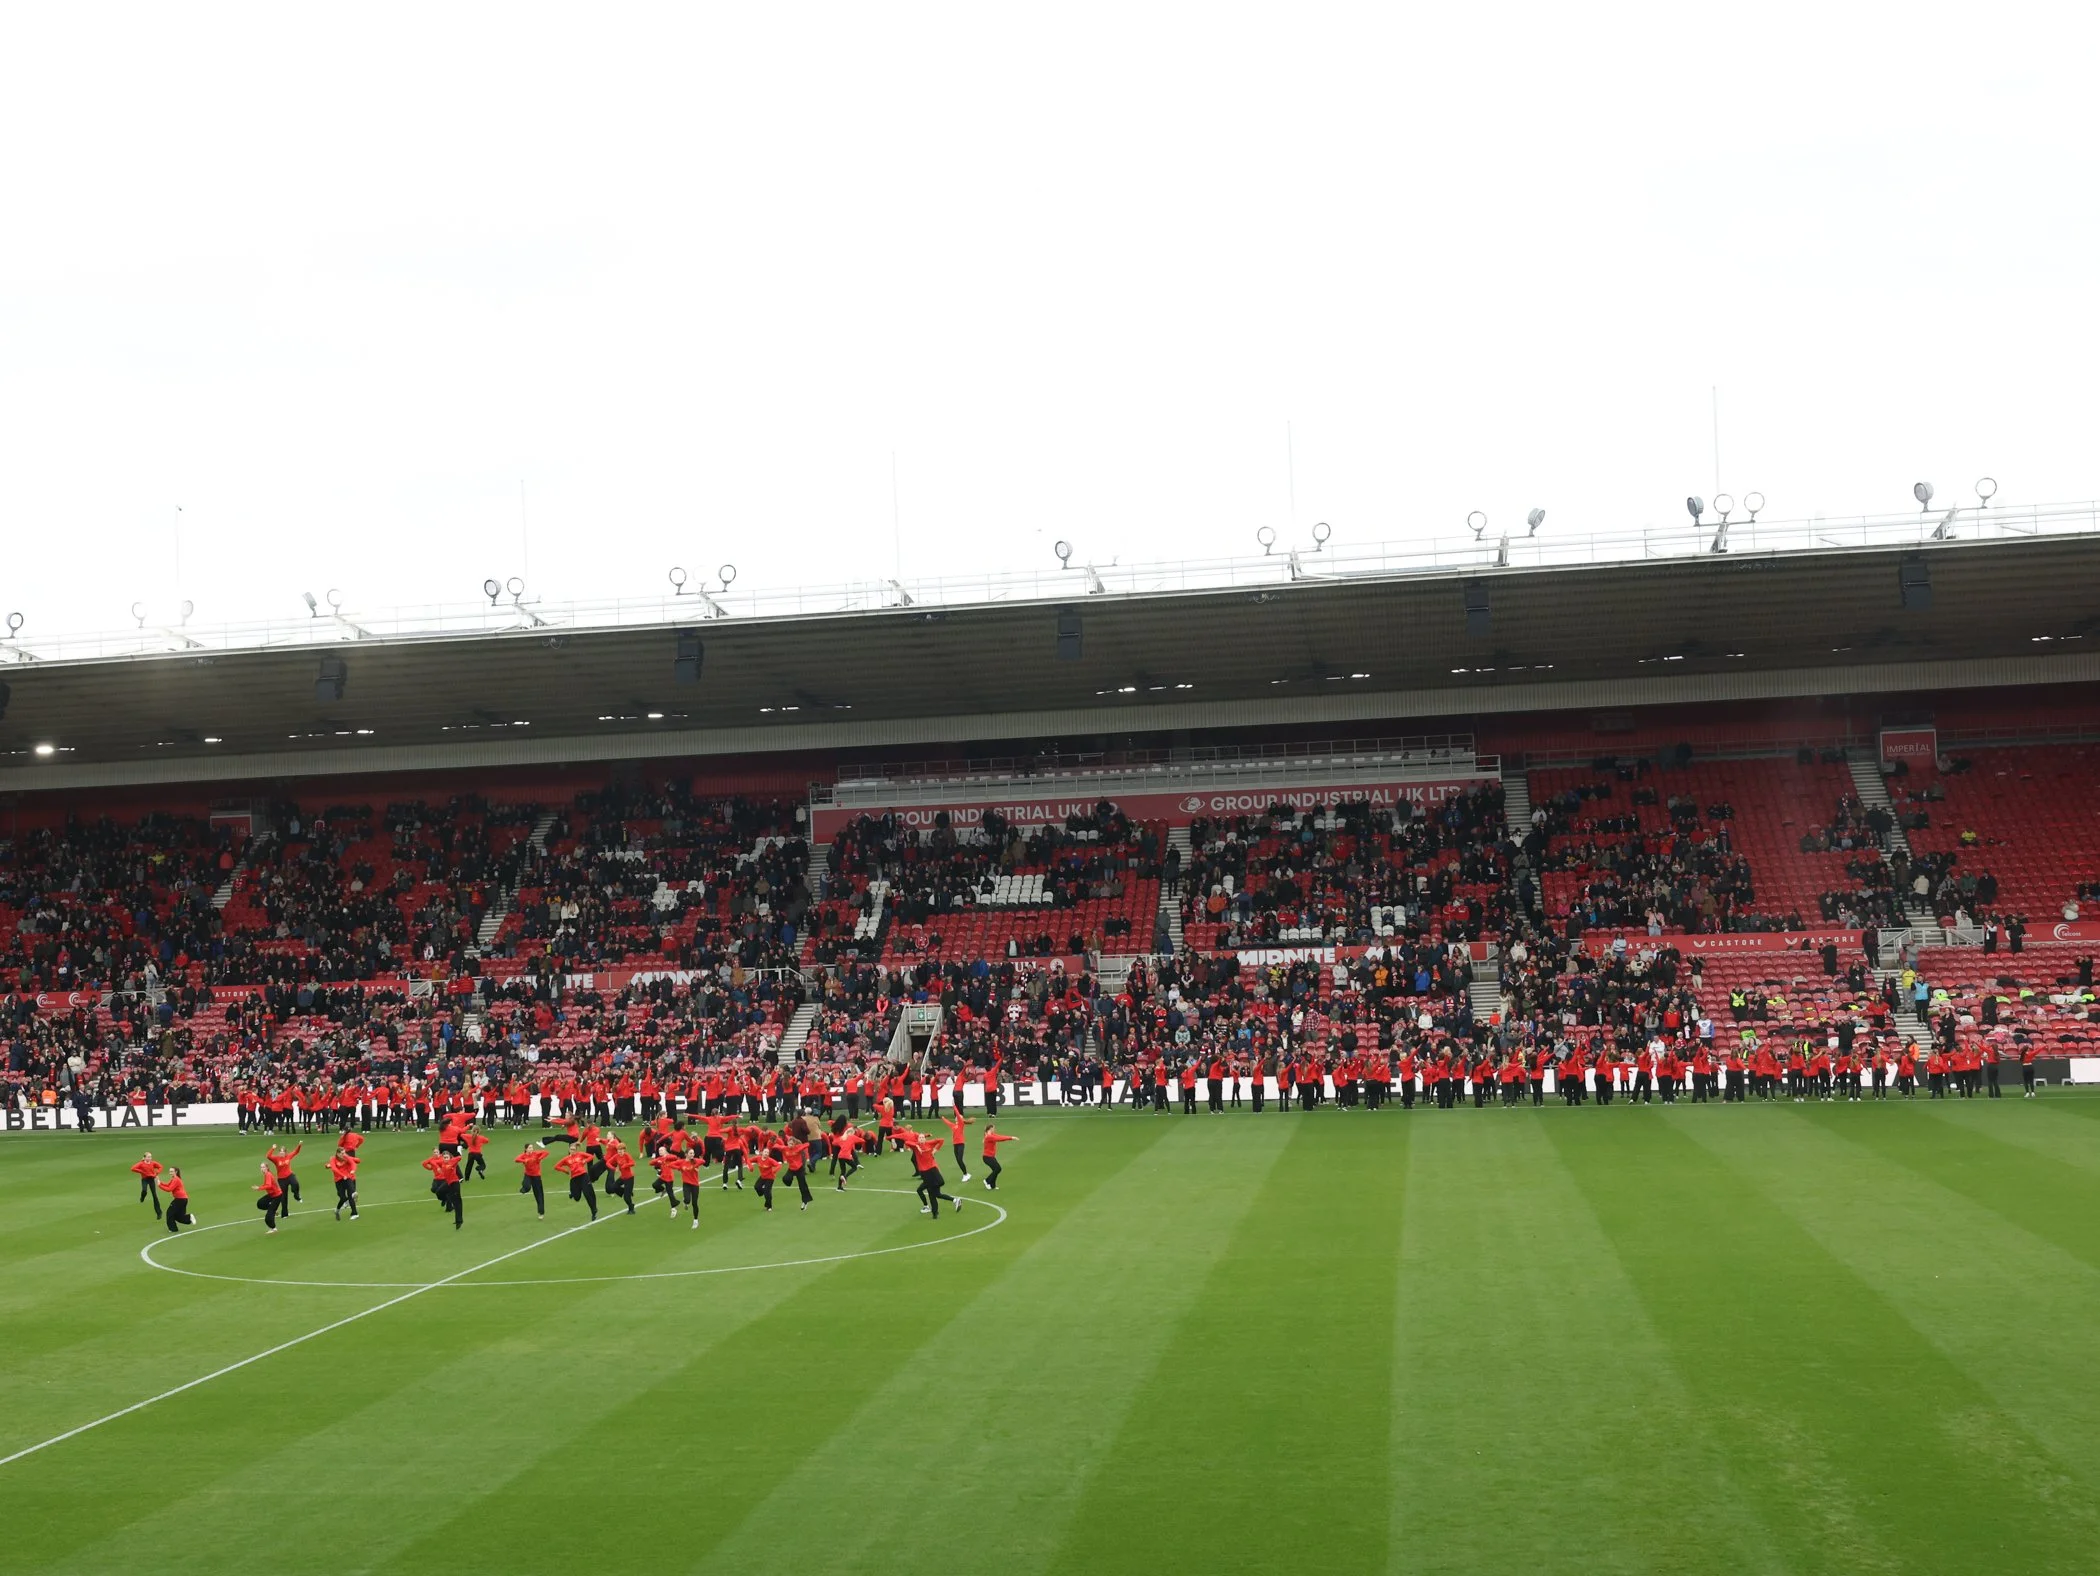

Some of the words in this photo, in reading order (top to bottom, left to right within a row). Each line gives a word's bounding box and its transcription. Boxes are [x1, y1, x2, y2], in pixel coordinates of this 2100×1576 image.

[1886, 743, 1931, 753] IMPERIAL
[1210, 794, 1278, 811] GROUP
[1282, 788, 1394, 807] INDUSTRIAL
[1398, 787, 1424, 802] UK
[1057, 803, 1081, 818] UK
[1710, 938, 1762, 947] CASTORE
[1237, 948, 1335, 966] MIDNITE
